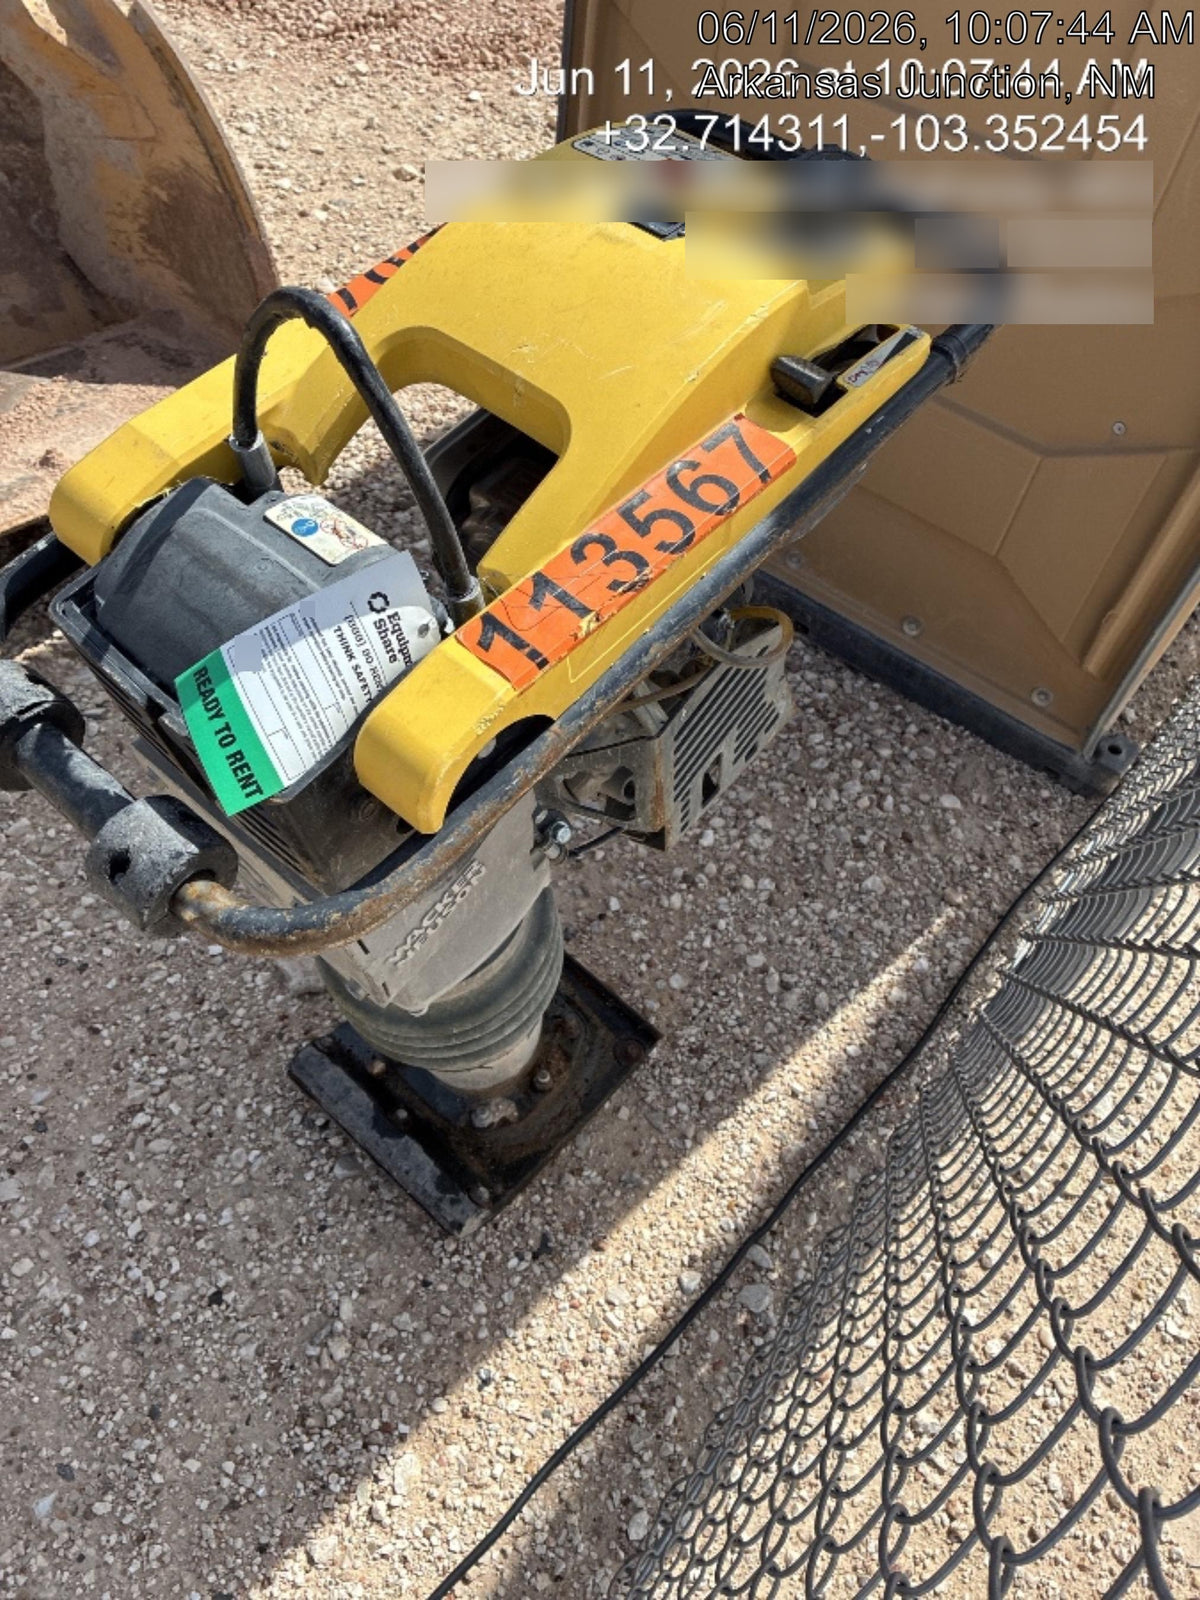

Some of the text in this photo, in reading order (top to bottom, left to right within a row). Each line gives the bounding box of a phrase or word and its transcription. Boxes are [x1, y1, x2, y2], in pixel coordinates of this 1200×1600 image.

[477, 423, 772, 670] 113567
[332, 625, 355, 664] THINK
[372, 617, 399, 664] Share
[193, 665, 264, 799] READY TO RENT
